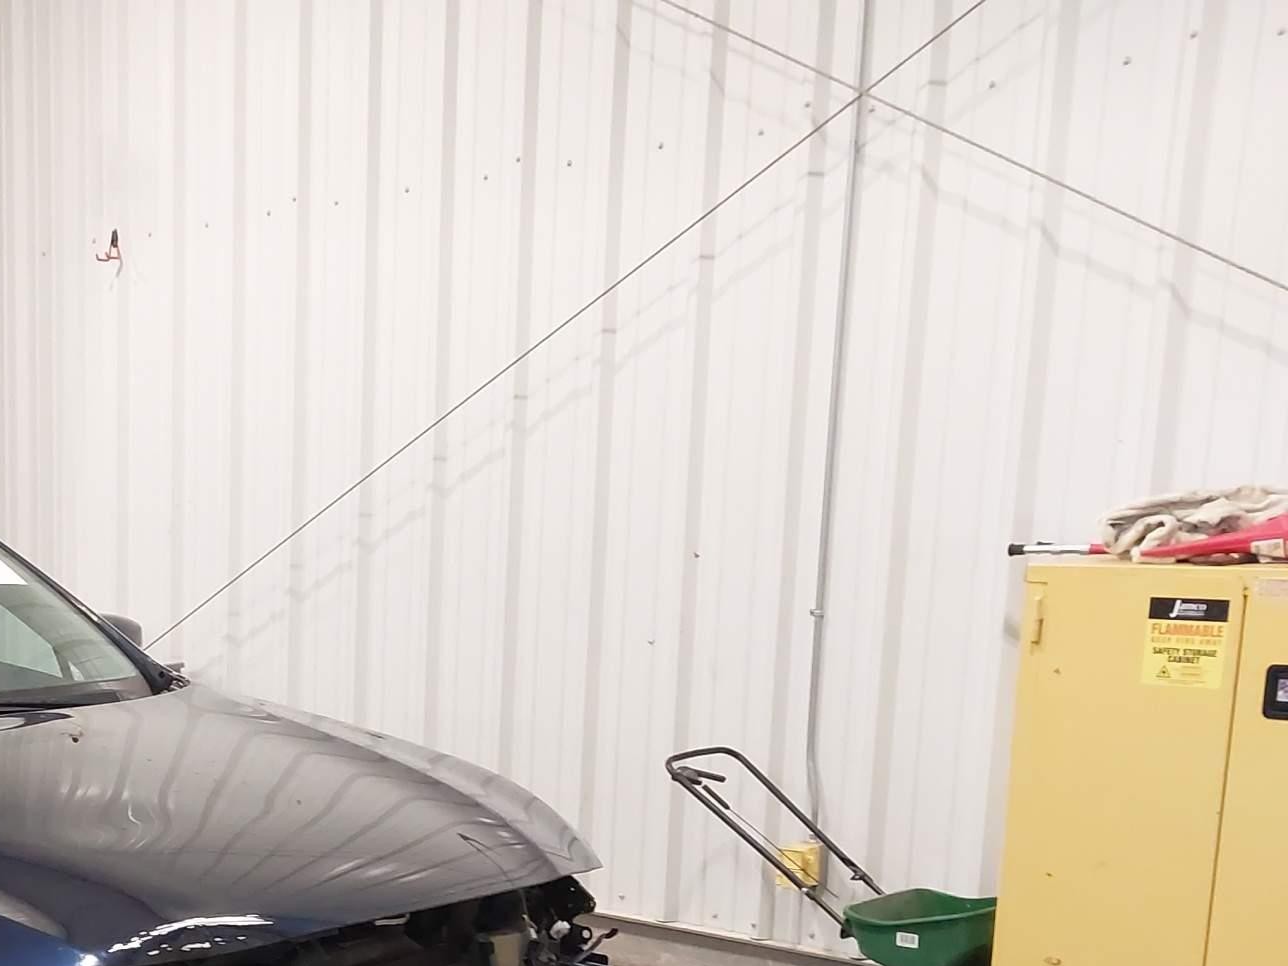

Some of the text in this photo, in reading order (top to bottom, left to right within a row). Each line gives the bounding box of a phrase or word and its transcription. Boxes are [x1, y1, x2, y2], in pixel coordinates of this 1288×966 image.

[1151, 623, 1224, 637] FLAMMABLE
[1153, 647, 1217, 657] SAFETY STORAGE
